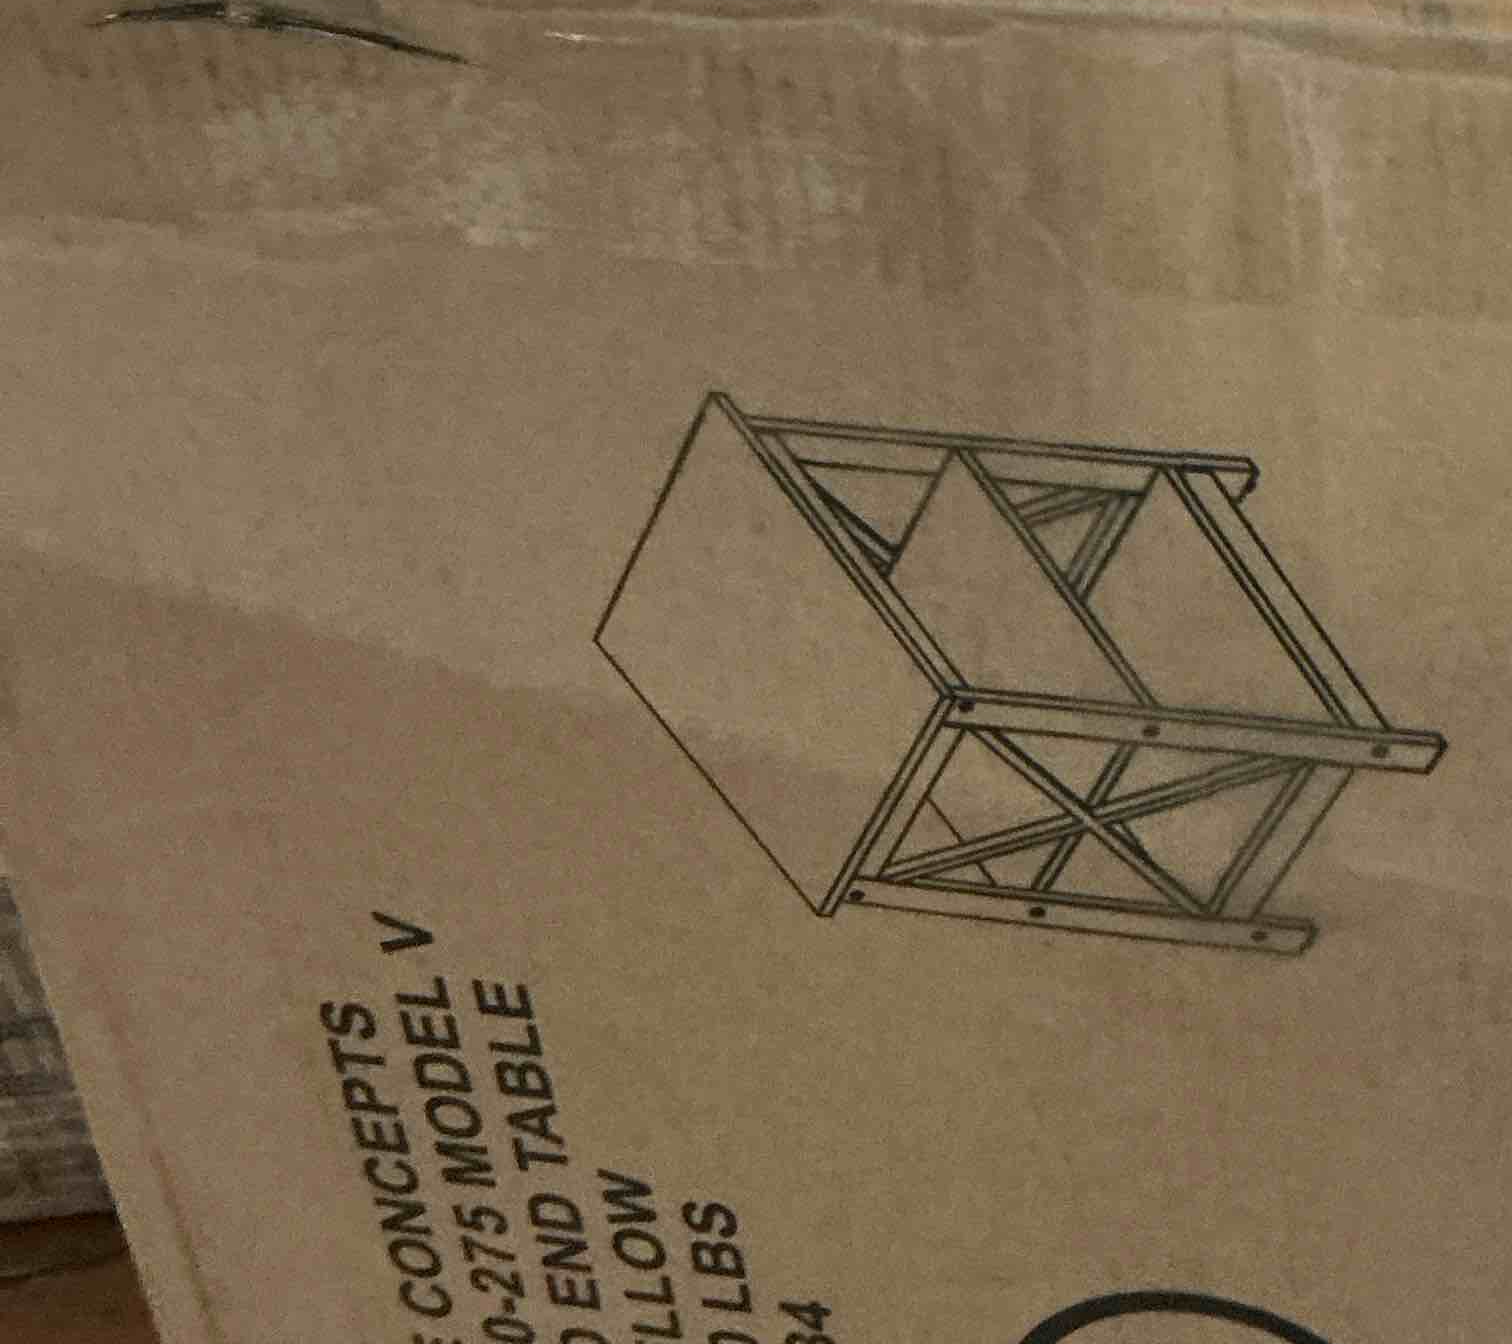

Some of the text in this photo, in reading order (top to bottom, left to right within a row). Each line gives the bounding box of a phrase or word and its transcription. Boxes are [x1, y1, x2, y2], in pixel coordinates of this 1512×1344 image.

[372, 909, 435, 953] V
[396, 975, 498, 1186] MODEL
[472, 977, 568, 1171] TABLE
[321, 999, 454, 1316] CONCEPTS
[526, 1192, 601, 1310] END
[681, 1198, 754, 1312] LBS
